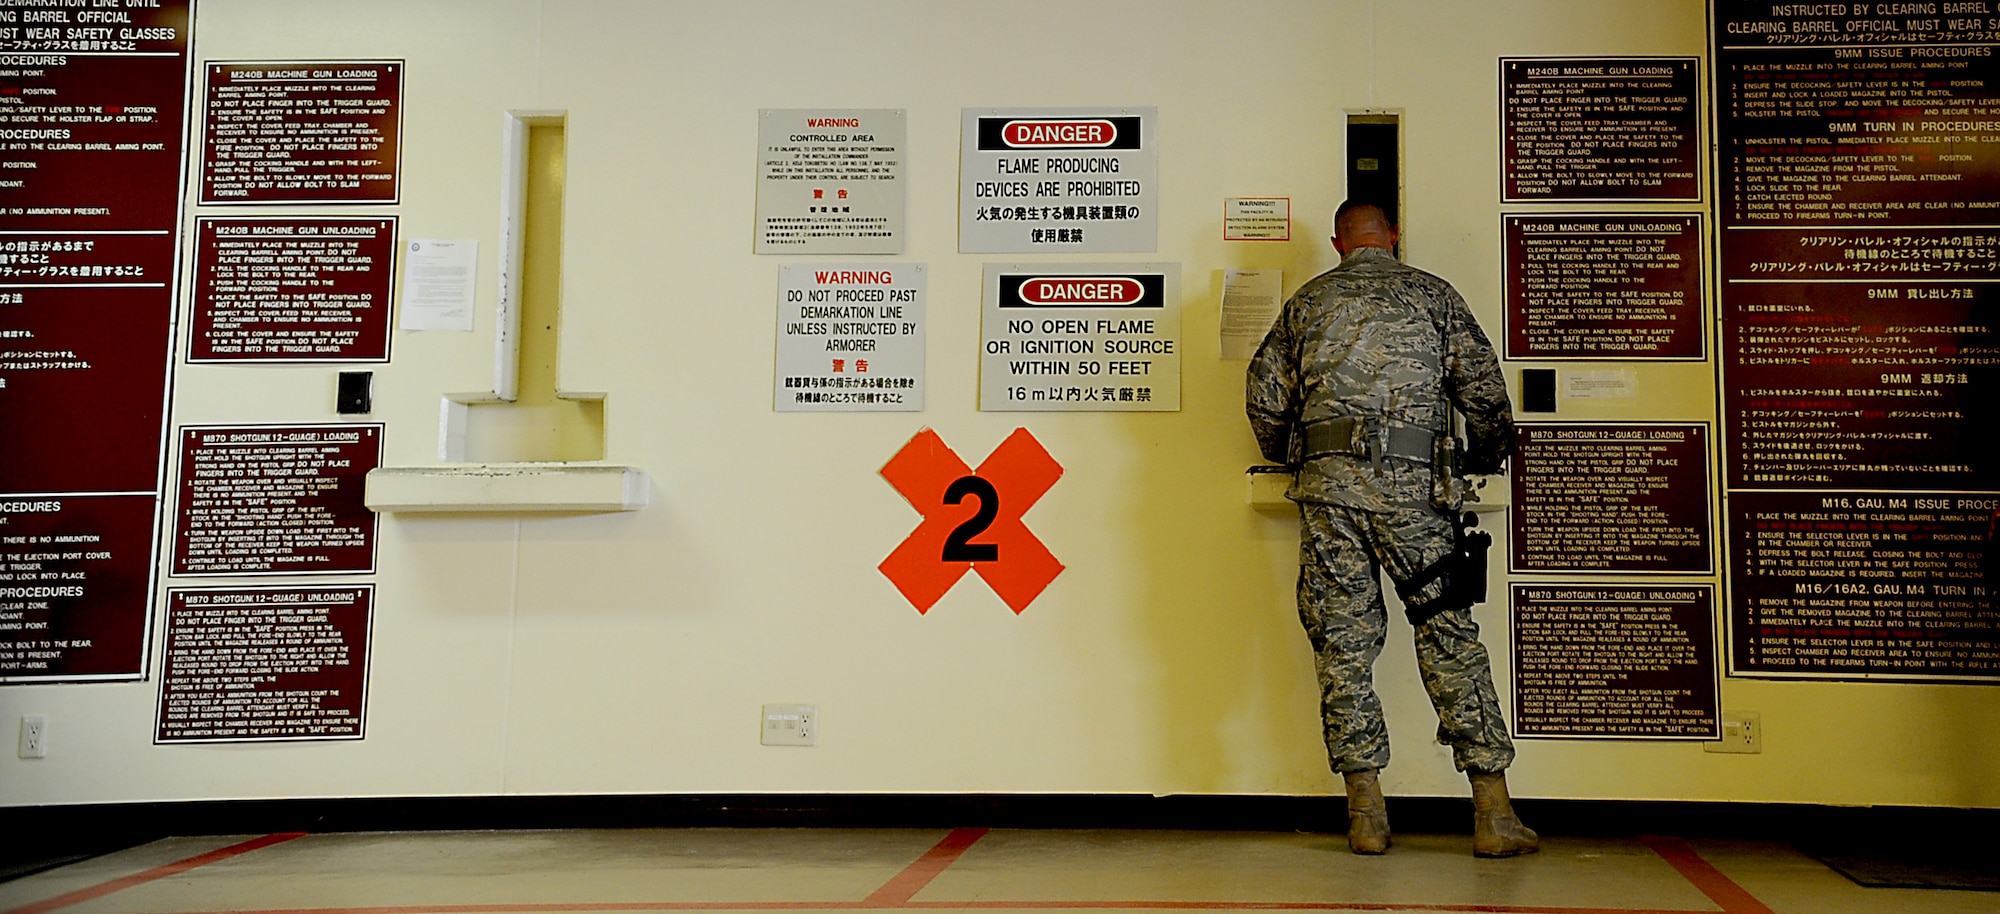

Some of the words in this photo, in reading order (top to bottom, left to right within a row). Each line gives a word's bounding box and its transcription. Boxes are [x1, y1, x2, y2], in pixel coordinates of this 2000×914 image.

[1772, 4, 1846, 16] INSTRUCTED
[1853, 3, 1868, 15] BY
[1876, 2, 1936, 15] CLEARING
[1943, 2, 1990, 14] BARREL
[23, 10, 70, 22] BARREL
[77, 10, 131, 23] OFFICIAL
[1727, 21, 1786, 33] CLEARING
[1792, 20, 1838, 33] BARREL
[1845, 19, 1899, 32] OFFICIAL
[1906, 19, 1940, 30] MUST
[1947, 18, 1981, 30] WEAR
[25, 27, 59, 39] WEAR
[66, 27, 113, 39] SAFETY
[119, 27, 175, 39] GLASSES
[1834, 48, 1862, 58] 9MM
[1869, 48, 1903, 57] ISSUE
[1910, 46, 1991, 57] PROCEDURES
[230, 70, 262, 78] M240B
[267, 70, 308, 78] MACHINE
[336, 69, 377, 77] LOADING
[808, 117, 859, 127] WARNING
[1828, 122, 1856, 132] 9MM
[1863, 122, 1895, 131] TURN
[1902, 122, 1914, 131] IN
[1921, 122, 2000, 131] PROCEDURES
[1017, 124, 1102, 143] DANGER
[998, 158, 1039, 174] FLAME
[1046, 157, 1118, 173] PRODUCING
[976, 181, 1028, 197] DEVICES
[1035, 181, 1060, 197] ARE
[1067, 180, 1140, 196] PROHIBITED
[976, 204, 1139, 221] 火気の発生する機具装置類の
[1031, 228, 1082, 243] 使用厳禁
[1844, 248, 1995, 259] 待機線のところで待機すること
[815, 271, 892, 284] WARNING
[787, 289, 802, 302] DO
[808, 289, 830, 301] NOT
[836, 289, 884, 301] PROCEED
[889, 289, 916, 301] PAST
[1040, 283, 1123, 299] DANGER
[1867, 288, 1898, 298] 9MM
[1907, 288, 1973, 299] 貸し出し方法
[800, 306, 874, 318] DEMARKATION
[880, 306, 902, 318] LINE
[786, 322, 826, 334] UNLESS
[832, 322, 896, 334] INSTRUCTED
[902, 322, 916, 334] BY
[1008, 319, 1033, 333] NO
[1041, 319, 1088, 333] OPEN
[1097, 320, 1154, 334] FLAME
[825, 339, 875, 351] ARMORER
[986, 340, 1010, 354] OR
[1021, 340, 1093, 353] IGNITION
[1104, 340, 1173, 354] SOURCE
[1009, 361, 1069, 374] WITHIN
[1078, 361, 1100, 374] 50
[1108, 361, 1152, 374] FEET
[1880, 373, 1911, 383] 9MM
[1921, 373, 1968, 384] 返却方法
[795, 392, 903, 403] 待機線のところで待機すること
[1008, 386, 1026, 400] 16
[203, 434, 226, 442] M870
[942, 476, 1000, 562] 2
[54, 534, 99, 542] AMMUNITION
[0, 586, 83, 598] PROCEDURES
[307, 593, 354, 601] UNLOADING
[1649, 591, 1695, 599] UNLOADING
